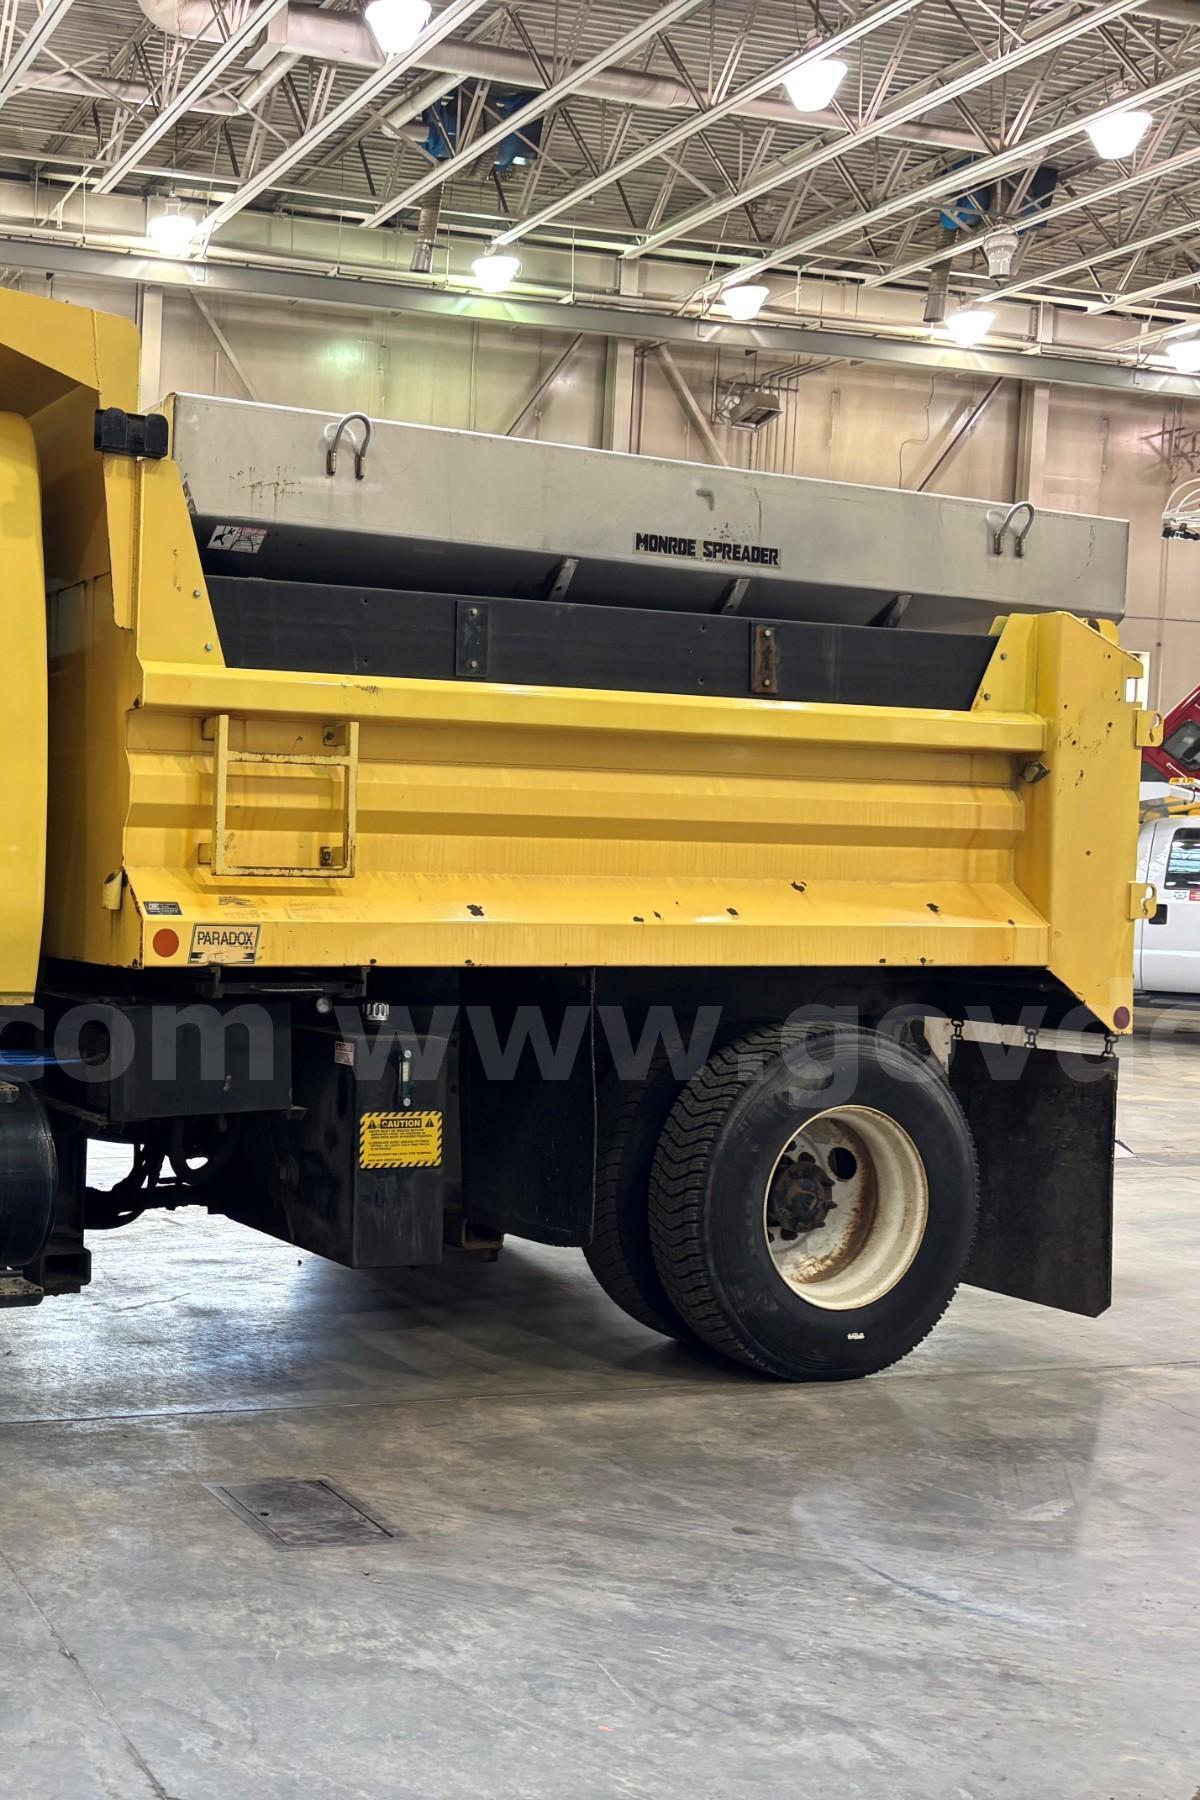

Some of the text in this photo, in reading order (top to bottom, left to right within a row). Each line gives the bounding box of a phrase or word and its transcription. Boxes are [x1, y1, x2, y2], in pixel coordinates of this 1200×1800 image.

[635, 532, 779, 566] MONROE SPREADER
[196, 930, 254, 947] PARADOX
[381, 1119, 421, 1129] CAUTION
